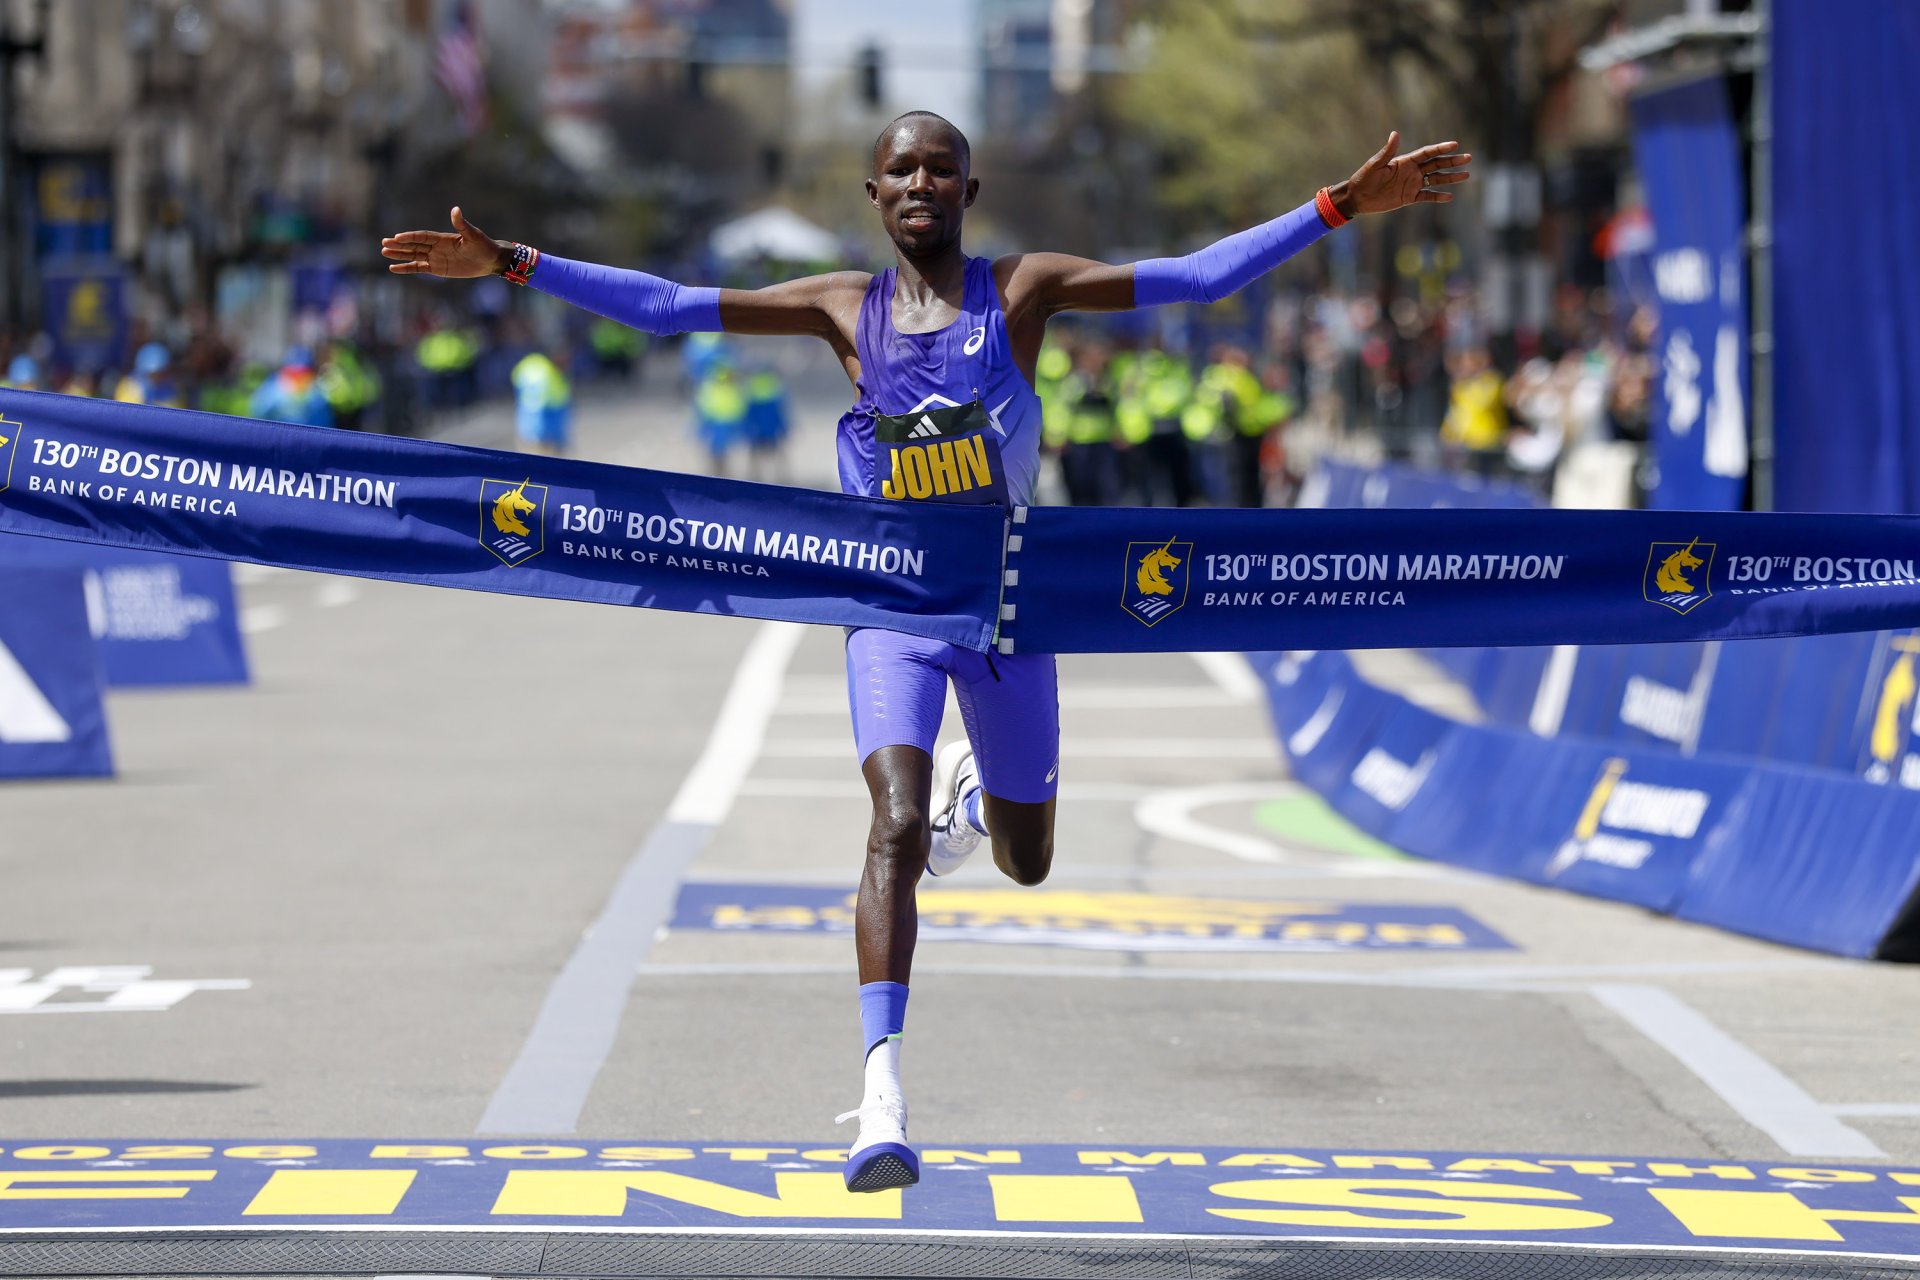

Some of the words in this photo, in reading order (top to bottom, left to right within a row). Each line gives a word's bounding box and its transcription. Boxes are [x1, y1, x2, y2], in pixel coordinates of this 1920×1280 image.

[32, 438, 98, 469] 130TH
[99, 447, 222, 488] BOSTON
[228, 464, 395, 508] MARATHON
[881, 434, 993, 500] JOHN
[29, 475, 92, 498] BANK
[98, 484, 128, 502] OF
[133, 489, 238, 517] AMERICA
[560, 503, 623, 534] 130TH
[626, 512, 746, 554] BOSTON
[753, 528, 924, 577] MARATHON
[562, 541, 624, 561] BANK
[630, 550, 659, 564] OF
[666, 554, 771, 577] AMERICA
[1205, 554, 1267, 581] 130TH
[1271, 553, 1388, 581] BOSTON
[1396, 554, 1564, 580] MARATHON
[1727, 556, 1790, 581] 130TH
[1793, 557, 1916, 582] BOSTON
[1203, 592, 1265, 606] BANK
[1270, 591, 1300, 606] OF
[1303, 591, 1406, 606] AMERICA
[1730, 586, 1796, 595] BANK
[1839, 578, 1920, 589] AMERI
[0, 1145, 316, 1160] 026
